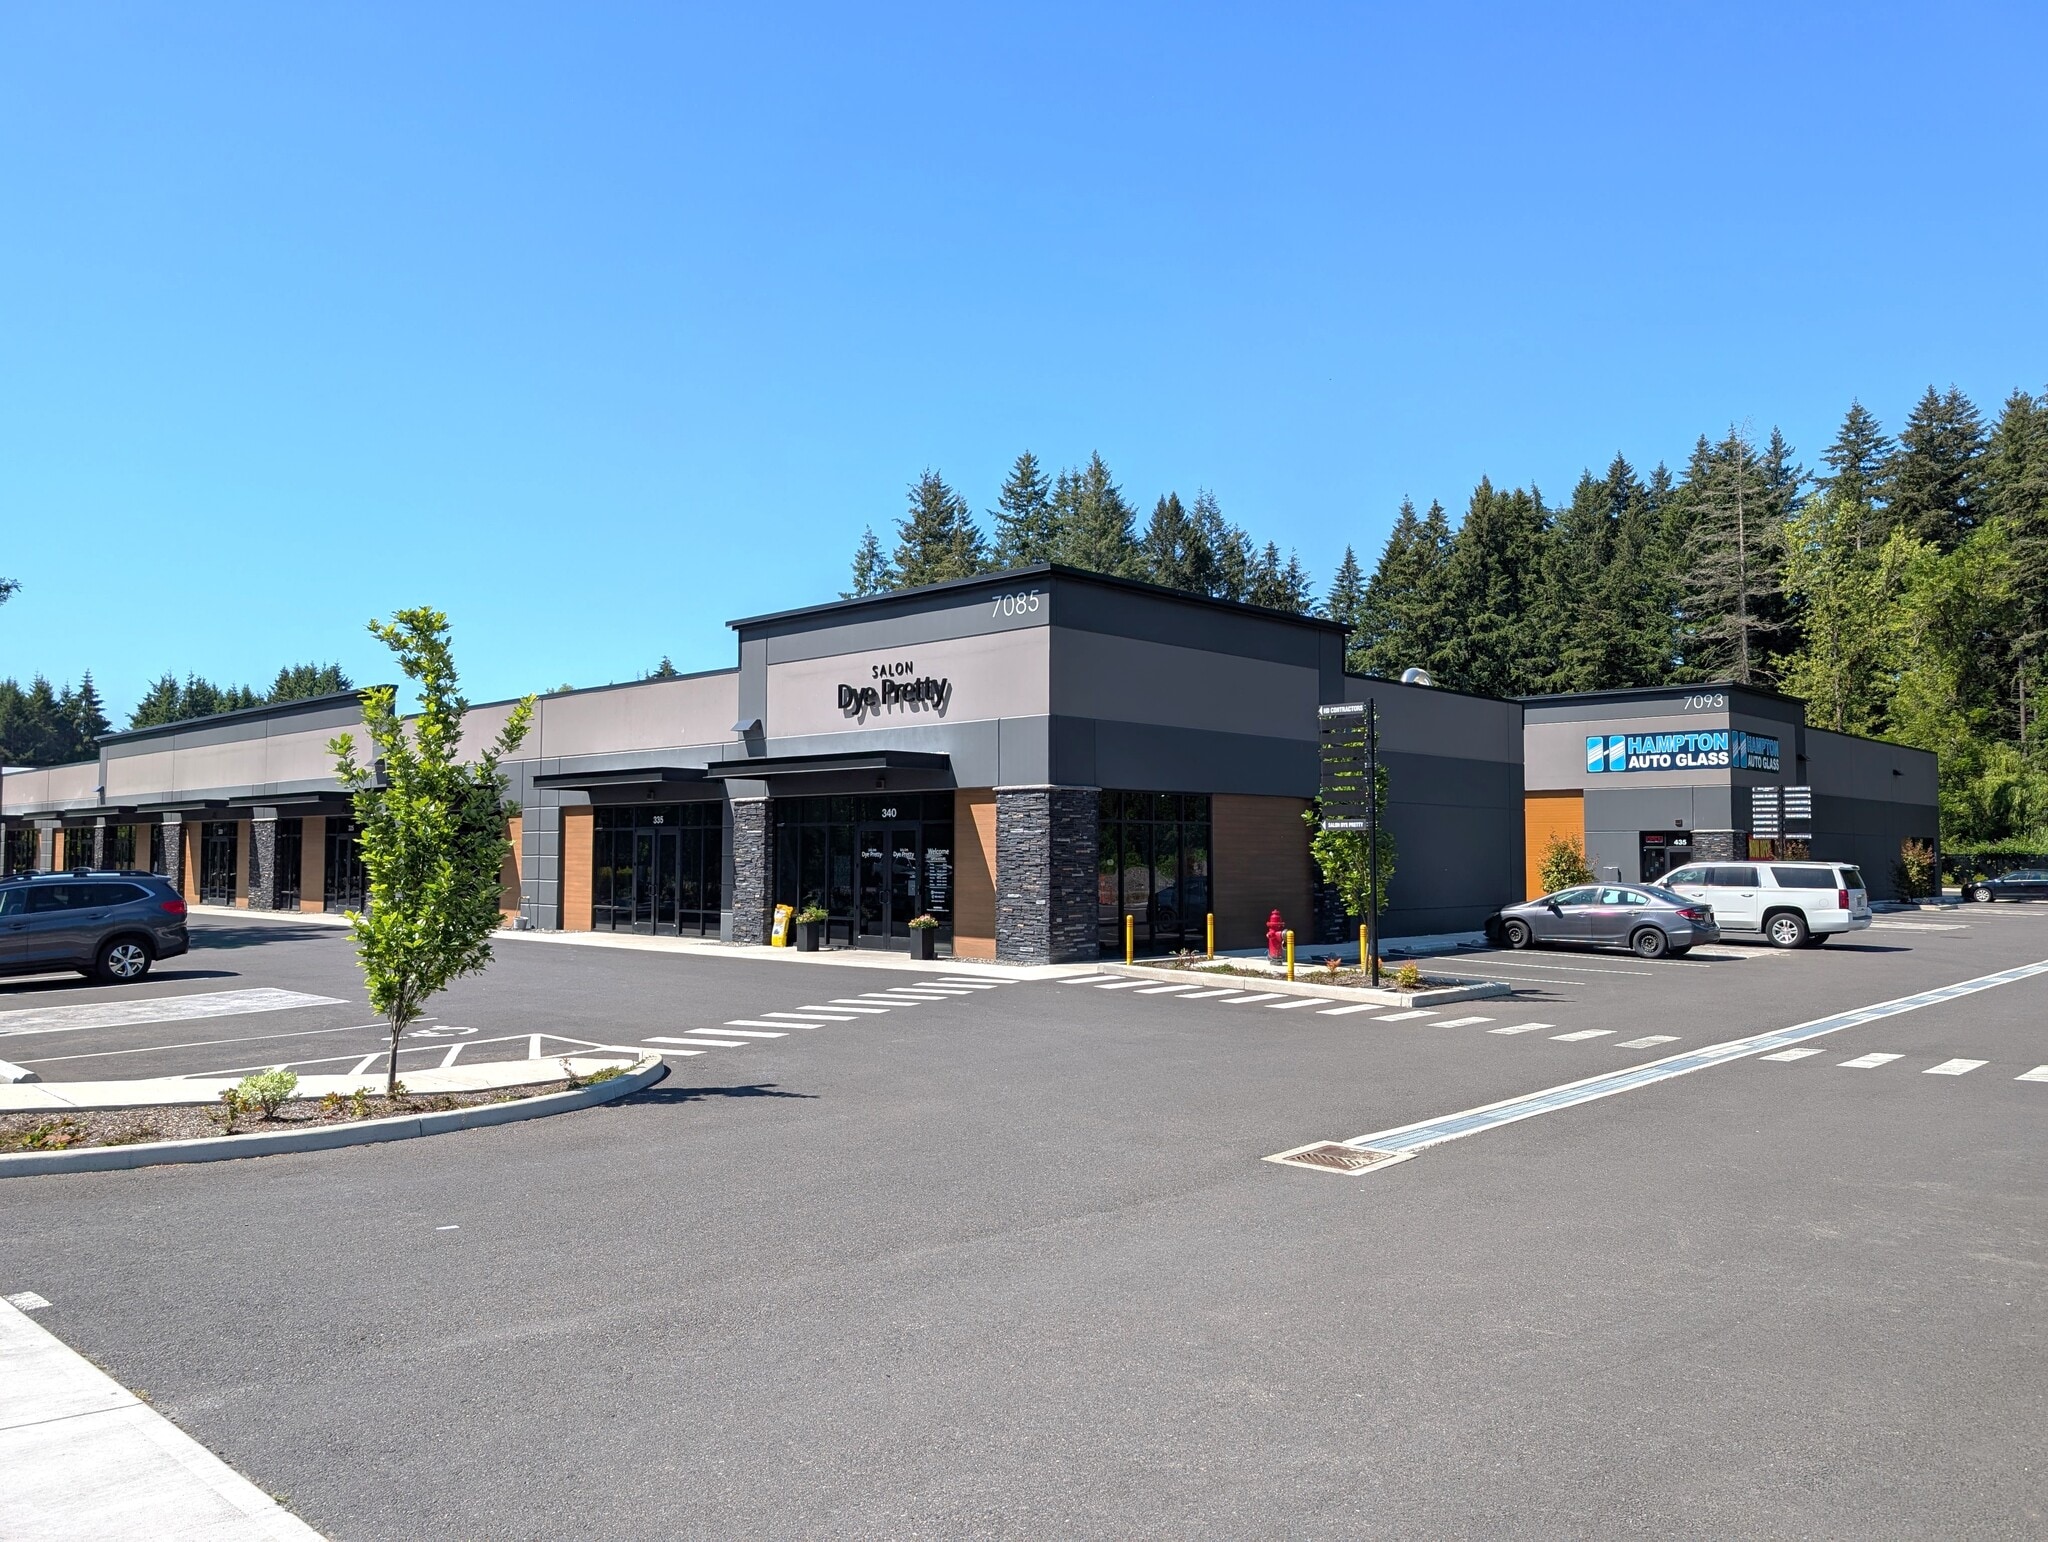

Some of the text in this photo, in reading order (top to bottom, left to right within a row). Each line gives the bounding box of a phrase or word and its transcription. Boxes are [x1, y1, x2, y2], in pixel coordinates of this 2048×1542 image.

[992, 590, 1040, 618] 7085
[872, 661, 914, 679] SALON
[838, 676, 948, 715] Dye Pretty
[1683, 694, 1723, 710] 7093
[1628, 732, 1728, 754] HAMPTON
[1746, 736, 1779, 756] HAMPTON
[1628, 752, 1729, 769] AUTO GLASS
[1748, 757, 1779, 771] AUTO GLASS
[882, 808, 897, 818] 340
